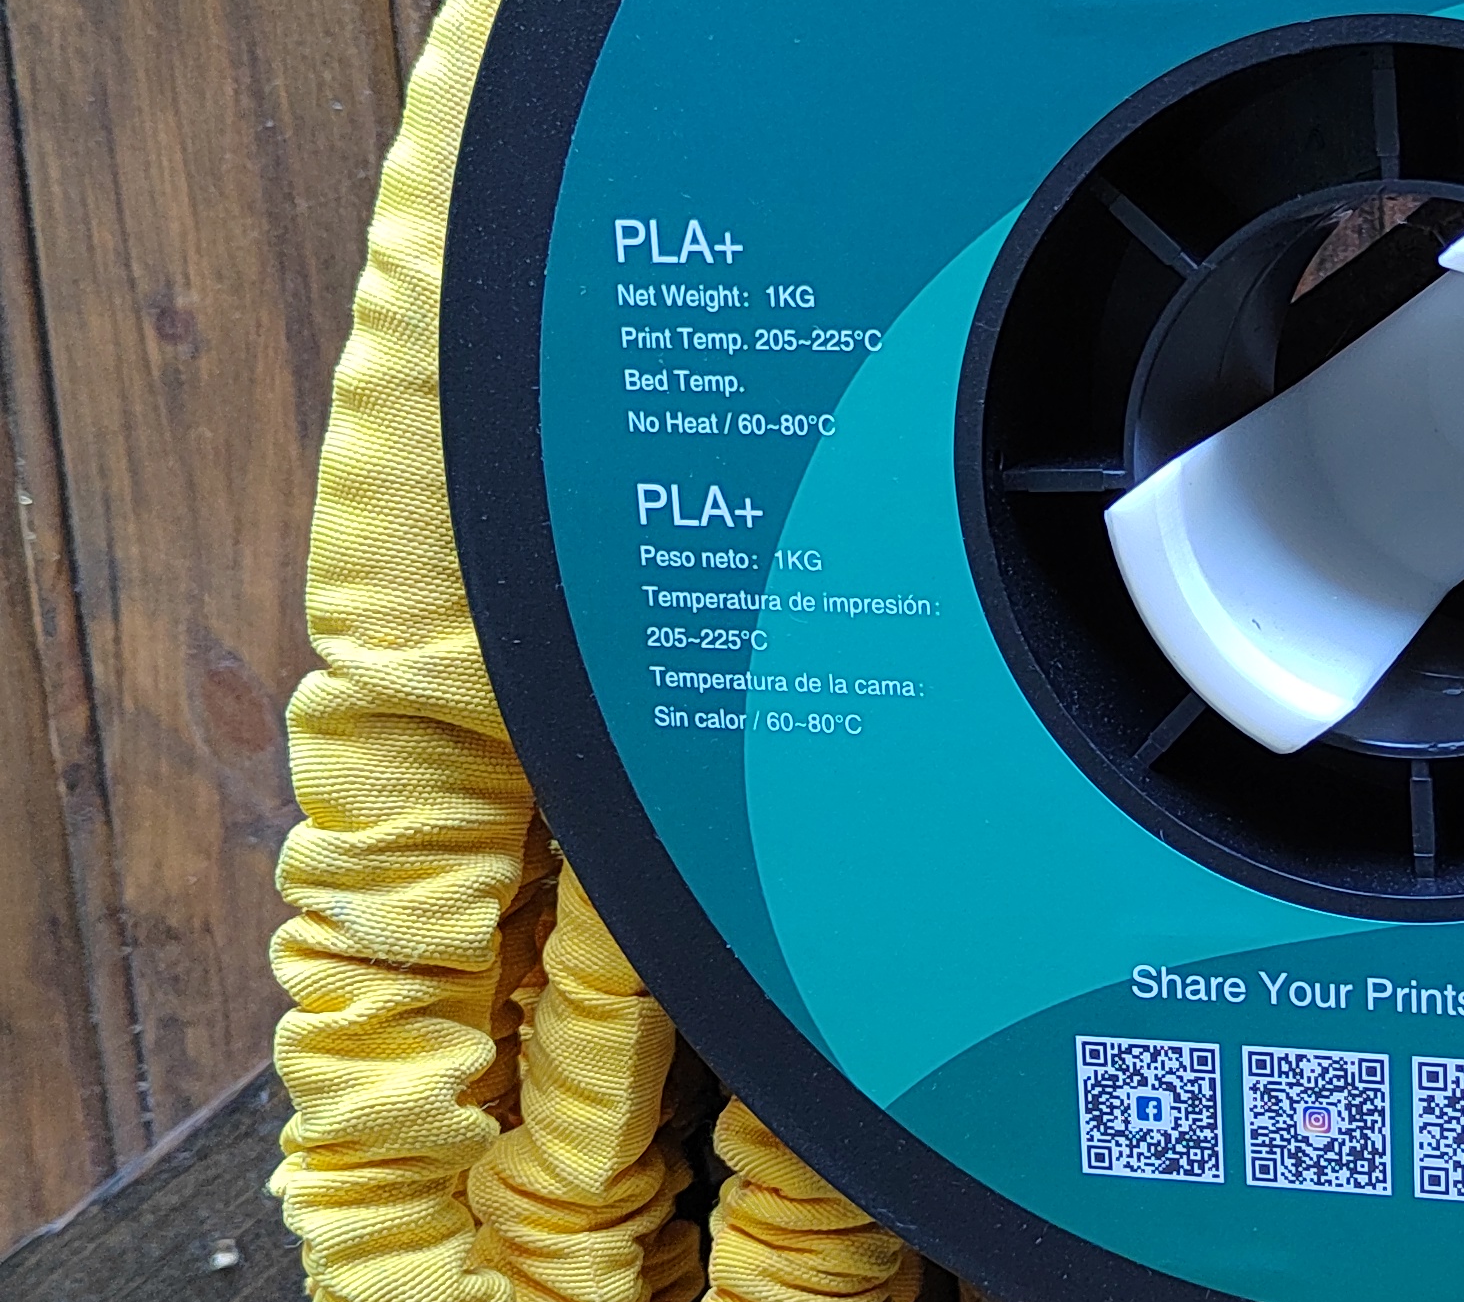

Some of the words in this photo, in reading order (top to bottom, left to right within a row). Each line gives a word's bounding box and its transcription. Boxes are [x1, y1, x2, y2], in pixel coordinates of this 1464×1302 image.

[615, 219, 743, 264] PLA+
[617, 284, 656, 307] Net
[661, 284, 749, 312] Weight:
[765, 286, 815, 308] 1KG
[621, 327, 672, 349] Print
[676, 328, 748, 355] Temp.
[624, 369, 668, 391] Bed
[673, 370, 745, 397] Temp.
[628, 411, 659, 433] No
[666, 412, 718, 434] Heat
[723, 412, 732, 434] /
[637, 483, 763, 528] PLA+
[640, 545, 695, 567] Peso
[702, 548, 758, 570] neto:
[774, 550, 822, 571] 1KG
[641, 585, 782, 613] Temperatura
[789, 590, 816, 612] de
[823, 593, 940, 618] impresión:
[649, 666, 788, 693] Temperatura
[795, 672, 821, 692] de
[829, 674, 848, 694] la
[855, 679, 925, 697] cama:
[654, 706, 688, 728] Sin
[695, 708, 747, 729] calor
[753, 710, 760, 731] /
[1131, 964, 1247, 1003] Share
[1258, 970, 1353, 1010] Your
